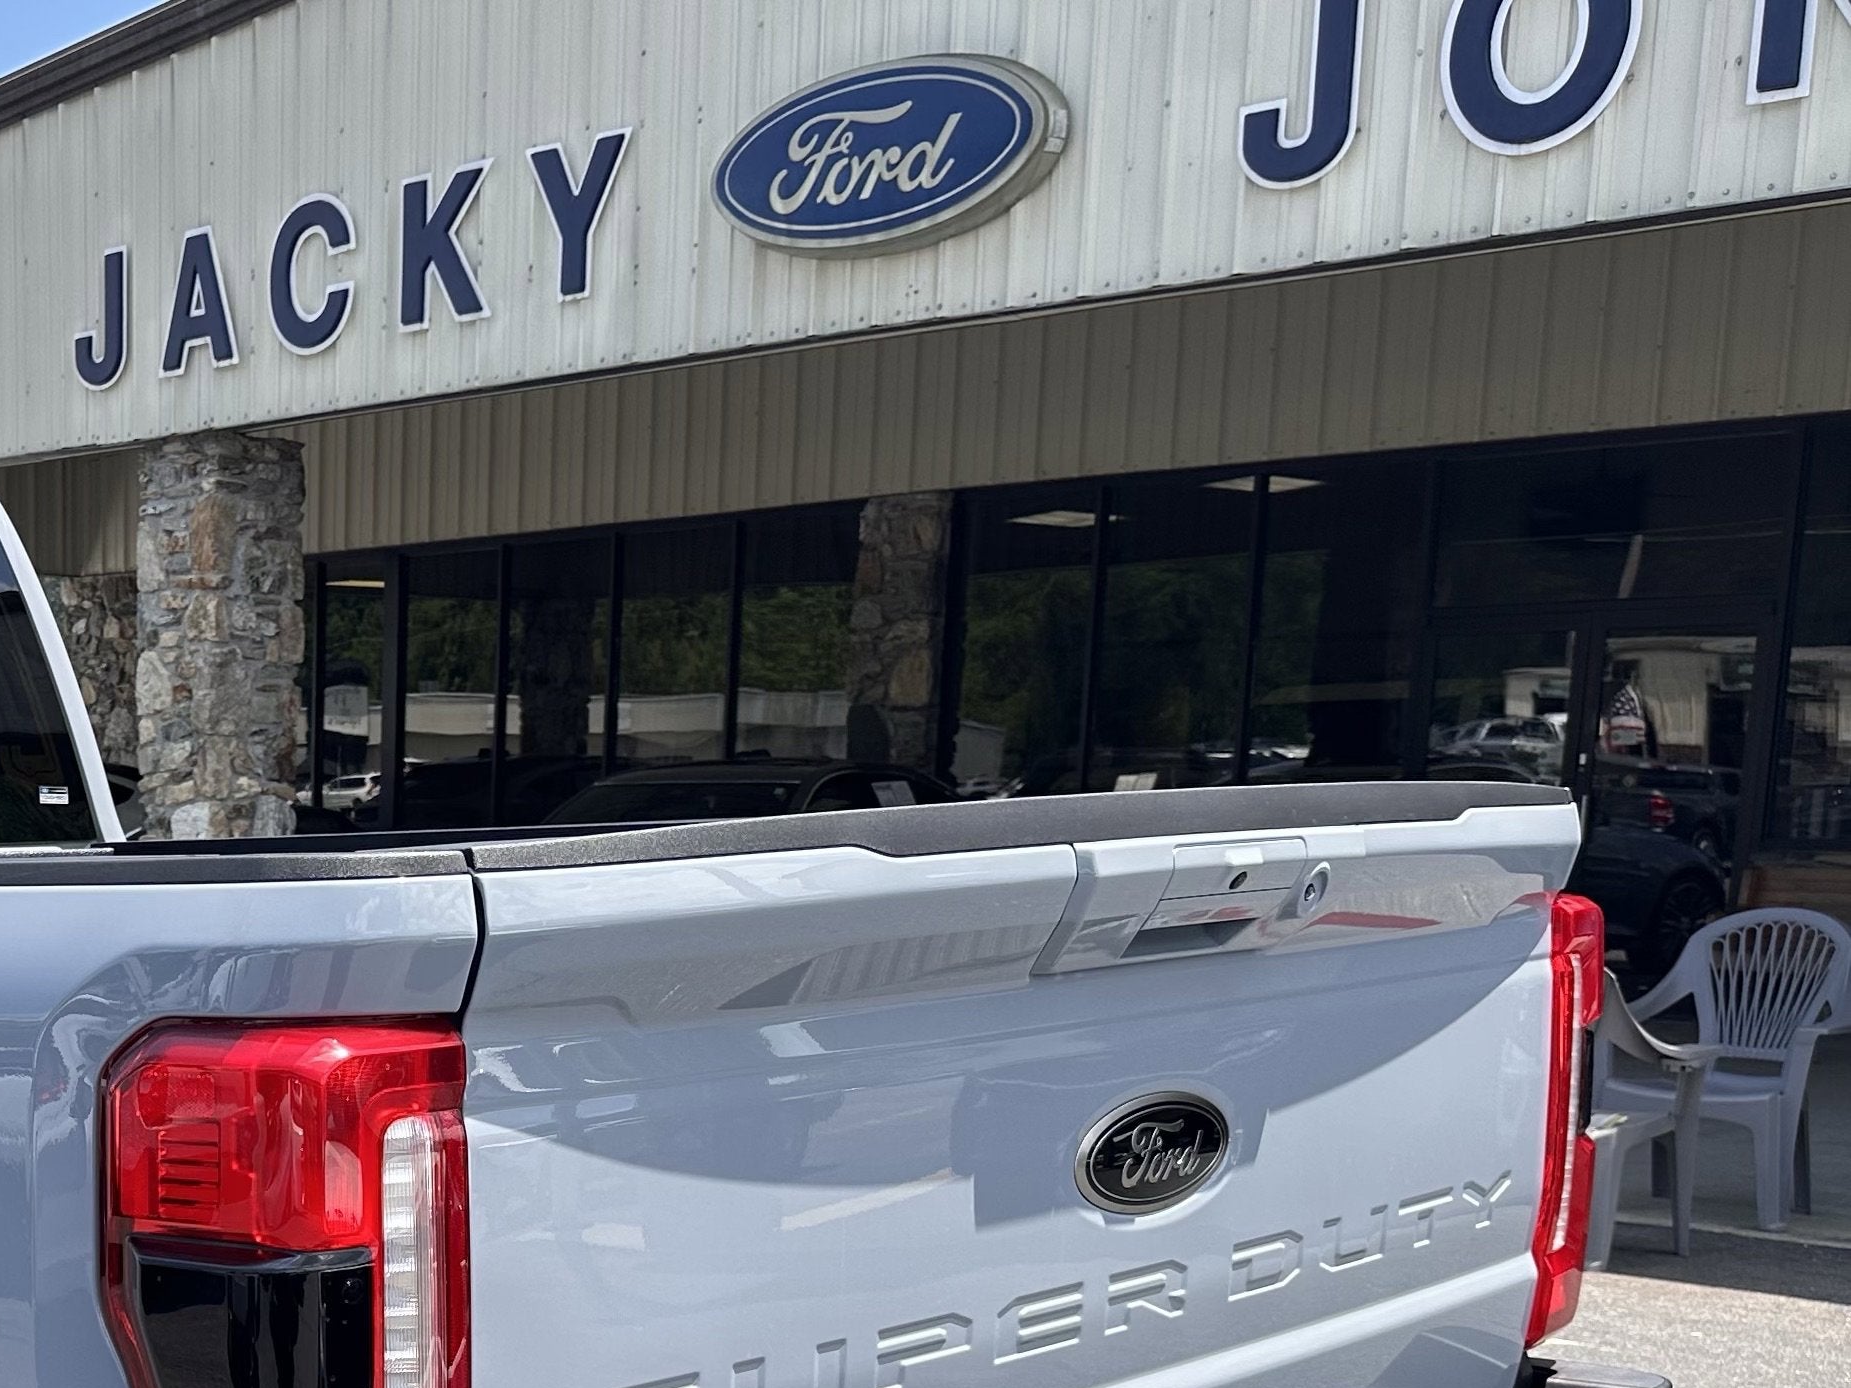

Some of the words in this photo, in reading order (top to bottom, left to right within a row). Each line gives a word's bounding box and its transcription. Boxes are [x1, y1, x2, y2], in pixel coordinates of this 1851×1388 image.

[768, 98, 957, 218] Ford
[1238, 0, 1851, 189] JO
[73, 126, 633, 392] JACKY
[1122, 1119, 1208, 1188] Ford
[1227, 1169, 1515, 1302] DUTY
